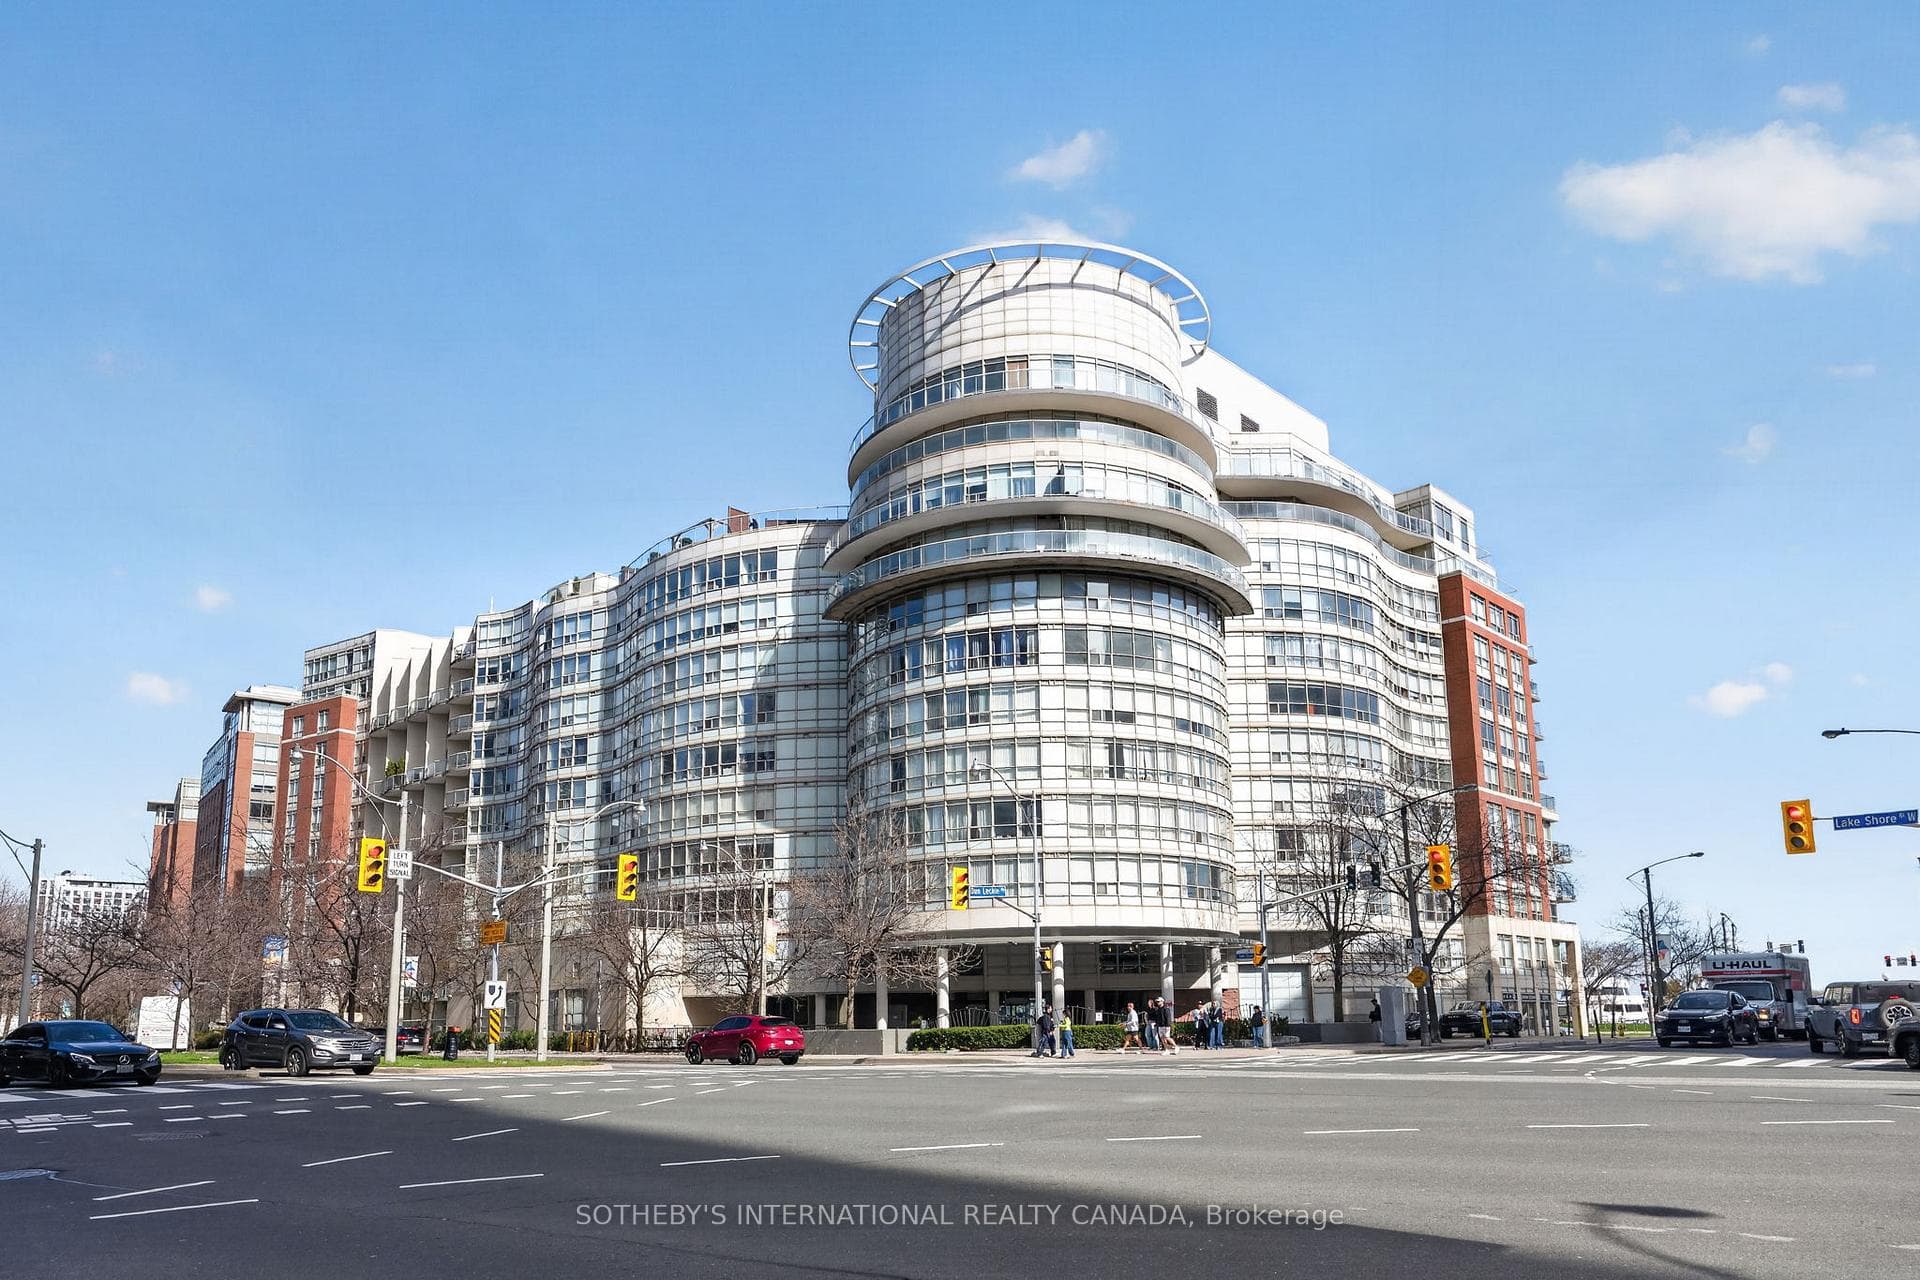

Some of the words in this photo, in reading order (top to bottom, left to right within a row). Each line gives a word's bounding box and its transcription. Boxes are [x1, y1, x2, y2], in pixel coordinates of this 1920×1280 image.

[1835, 817, 1860, 828] Lake
[1864, 815, 1897, 826] Shore
[1907, 811, 1917, 822] W
[393, 860, 408, 868] TURN
[389, 869, 409, 877] SIGNAL
[1712, 960, 1772, 969] U-HAUL
